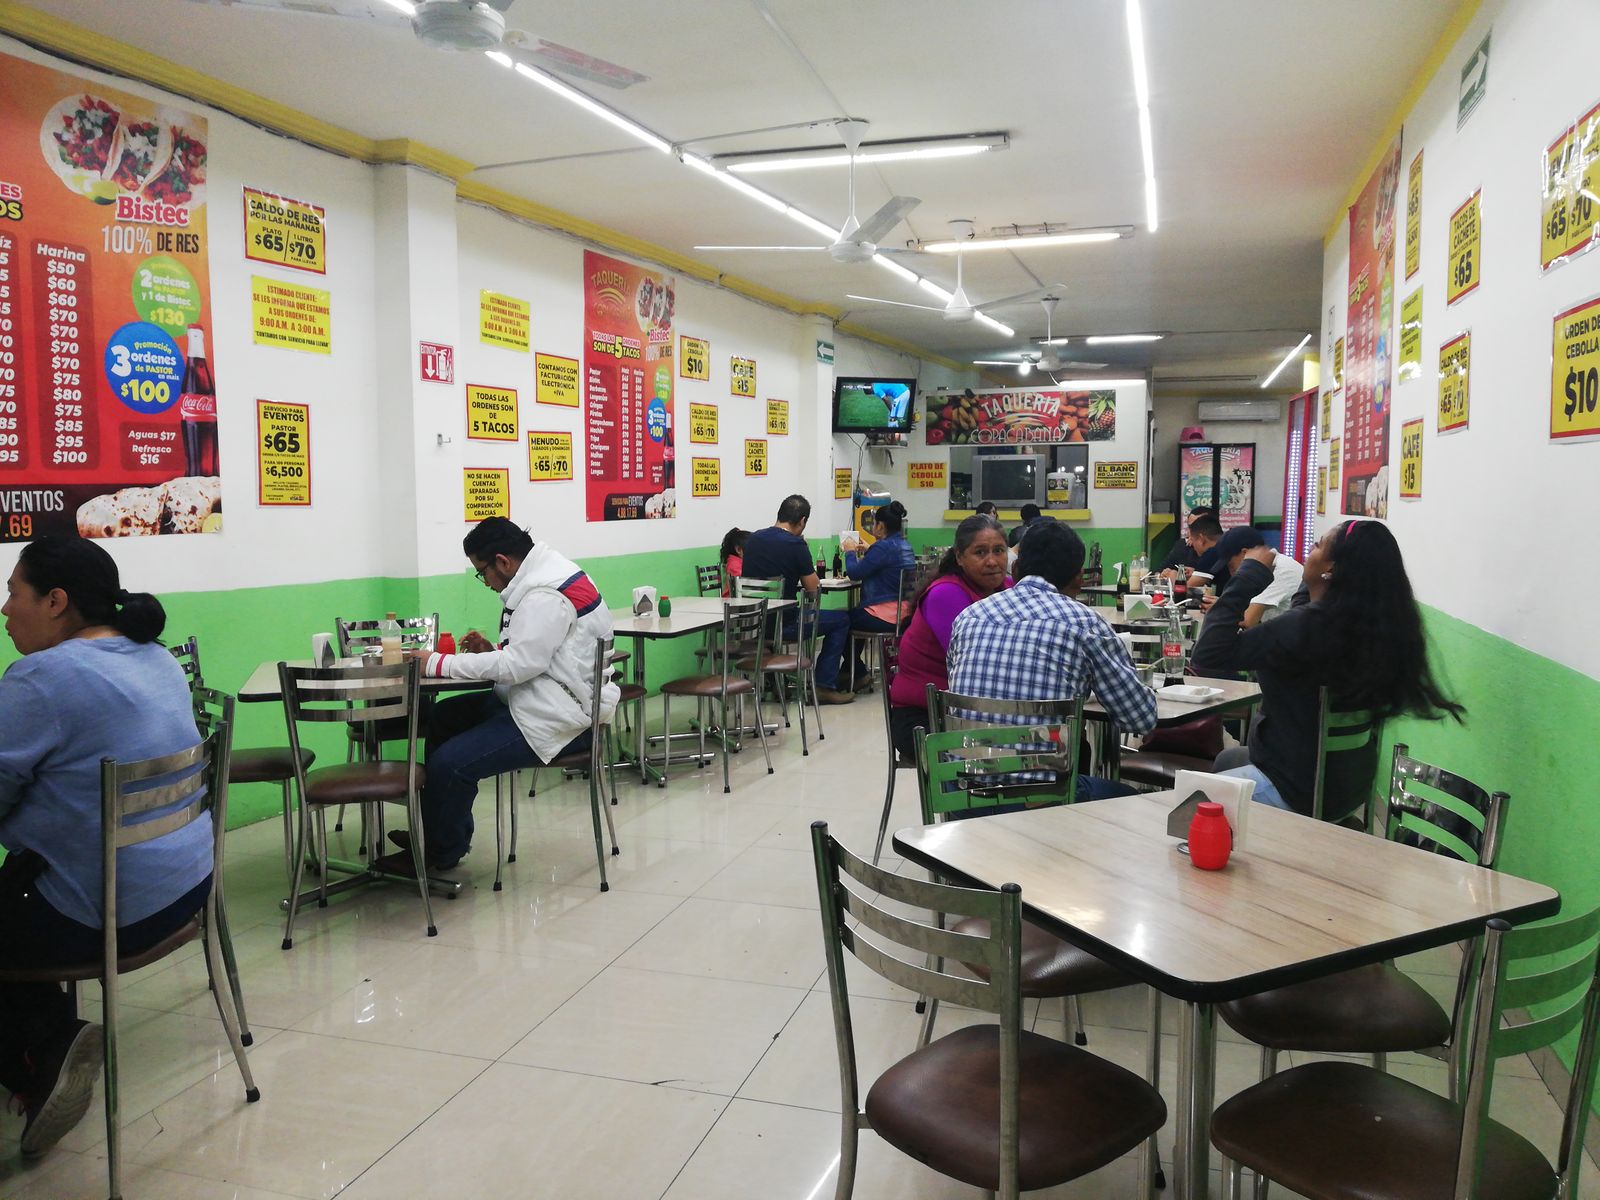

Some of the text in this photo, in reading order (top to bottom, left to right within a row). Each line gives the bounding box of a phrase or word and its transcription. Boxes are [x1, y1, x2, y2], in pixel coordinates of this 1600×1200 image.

[117, 196, 189, 225] Bistec
[250, 200, 320, 226] CALDO DE RES
[1454, 203, 1476, 232] TACOS DE
[1546, 195, 1592, 241] $65 $70
[250, 210, 321, 234] POR LAS MAÑANAS
[101, 225, 200, 255] 100% DE RES
[262, 226, 314, 243] PLATO LITRO
[1453, 219, 1476, 250] CACHETE
[37, 243, 85, 262] Harina
[255, 233, 316, 260] $65 $70
[47, 259, 76, 275] $50
[1454, 249, 1473, 288] $65
[48, 275, 77, 291] $60
[140, 269, 153, 288] 2
[48, 291, 77, 308] $60
[267, 285, 295, 298] ESTIMADO
[252, 292, 330, 316] SE LES INFORMA QUE ESTAMOS
[49, 307, 78, 323] $70
[150, 307, 185, 327] $130
[268, 307, 308, 321] A SUS ORDENES
[50, 323, 79, 339] $70
[259, 317, 326, 337] 9:00 A.M. A 3:00 A.M.
[650, 328, 669, 341] Bistec
[1564, 318, 1590, 340] ORDEN
[51, 339, 79, 355] $70
[593, 335, 640, 359] SON DE 5 TACOS
[1566, 337, 1600, 360] CEBOLLA
[51, 355, 80, 371] $70
[110, 344, 177, 377] 3 ordenes
[687, 355, 703, 374] $10
[135, 364, 173, 375] de PASTOR
[538, 362, 578, 376] CONTAMOS CON
[53, 371, 80, 386] $75
[737, 379, 749, 393] $15
[53, 387, 82, 402] $80
[120, 379, 170, 404] $100
[476, 392, 509, 403] TODAS LAS
[1564, 366, 1599, 422] $10
[55, 403, 82, 417] $75
[263, 405, 288, 413] SERVICIO
[472, 401, 514, 412] ORDENES SON
[1440, 393, 1452, 414] $65
[263, 411, 304, 423] EVENTOS
[489, 412, 497, 420] DE
[647, 409, 654, 425] 3
[55, 418, 84, 434] $85
[271, 424, 296, 432] PASTOR
[473, 420, 515, 434] 5 TACOS
[693, 426, 704, 436] $65
[55, 434, 84, 448] $95
[128, 430, 176, 441] Aguas $17
[264, 431, 300, 454] $65
[531, 437, 560, 446] MENUDO
[969, 426, 1065, 444] COPACABANA
[1402, 425, 1420, 461] CAFÉ
[53, 450, 88, 465] $100
[132, 445, 172, 454] Refresco
[140, 453, 160, 465] $16
[534, 460, 568, 472] $65 $70
[750, 459, 763, 472] $65
[265, 465, 303, 479] $6,500
[1110, 464, 1135, 473] BAÑO
[1404, 464, 1416, 490] $15
[695, 483, 718, 492] 5 TACOS
[1186, 485, 1195, 497] 3
[474, 509, 496, 517] GRACIAS
